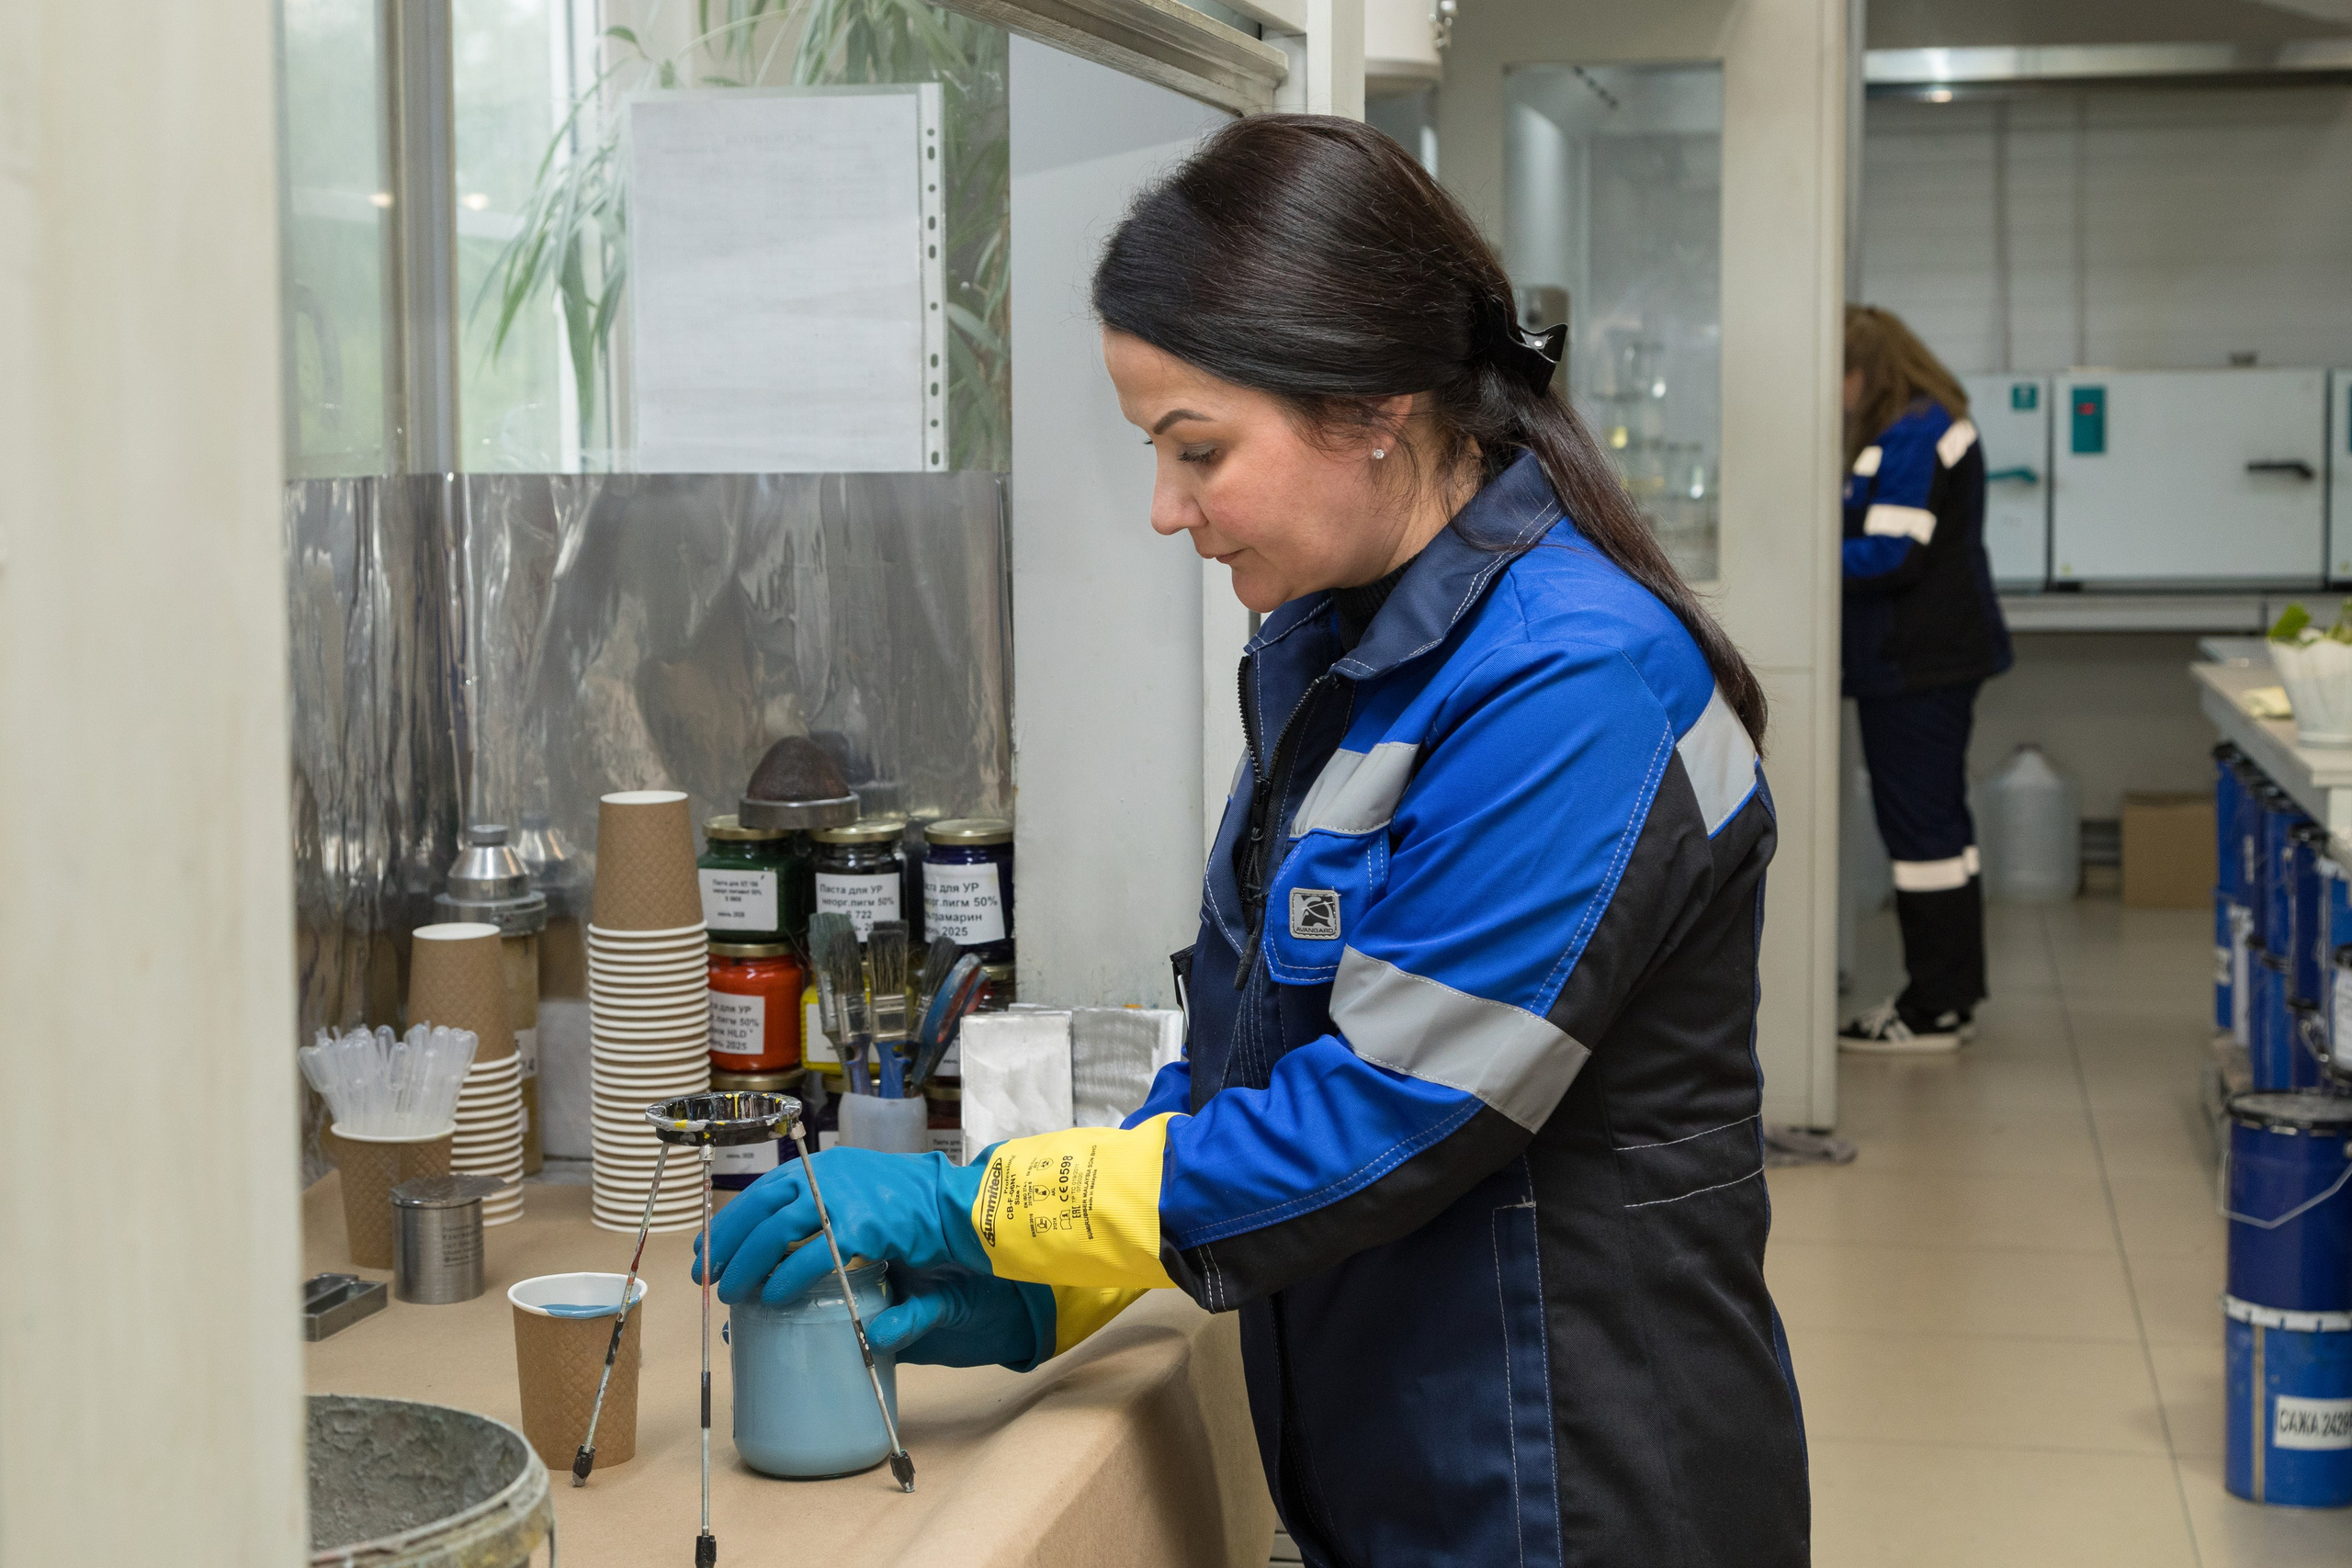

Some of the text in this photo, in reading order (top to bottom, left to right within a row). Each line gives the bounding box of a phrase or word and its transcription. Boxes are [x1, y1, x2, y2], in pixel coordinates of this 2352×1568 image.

[820, 884, 883, 896] Паста для УР
[939, 885, 959, 894] для
[963, 882, 979, 893] УР
[877, 897, 895, 907] 50%
[974, 896, 998, 908] 50%
[855, 910, 872, 919] 722
[942, 926, 968, 937] 2025
[1003, 1155, 1016, 1194] Professional
[1059, 1156, 1073, 1183] 0598
[1083, 1169, 1091, 1198] MALAYSIA
[983, 1163, 1001, 1242] Summitech
[2279, 1408, 2320, 1434] САЖА
